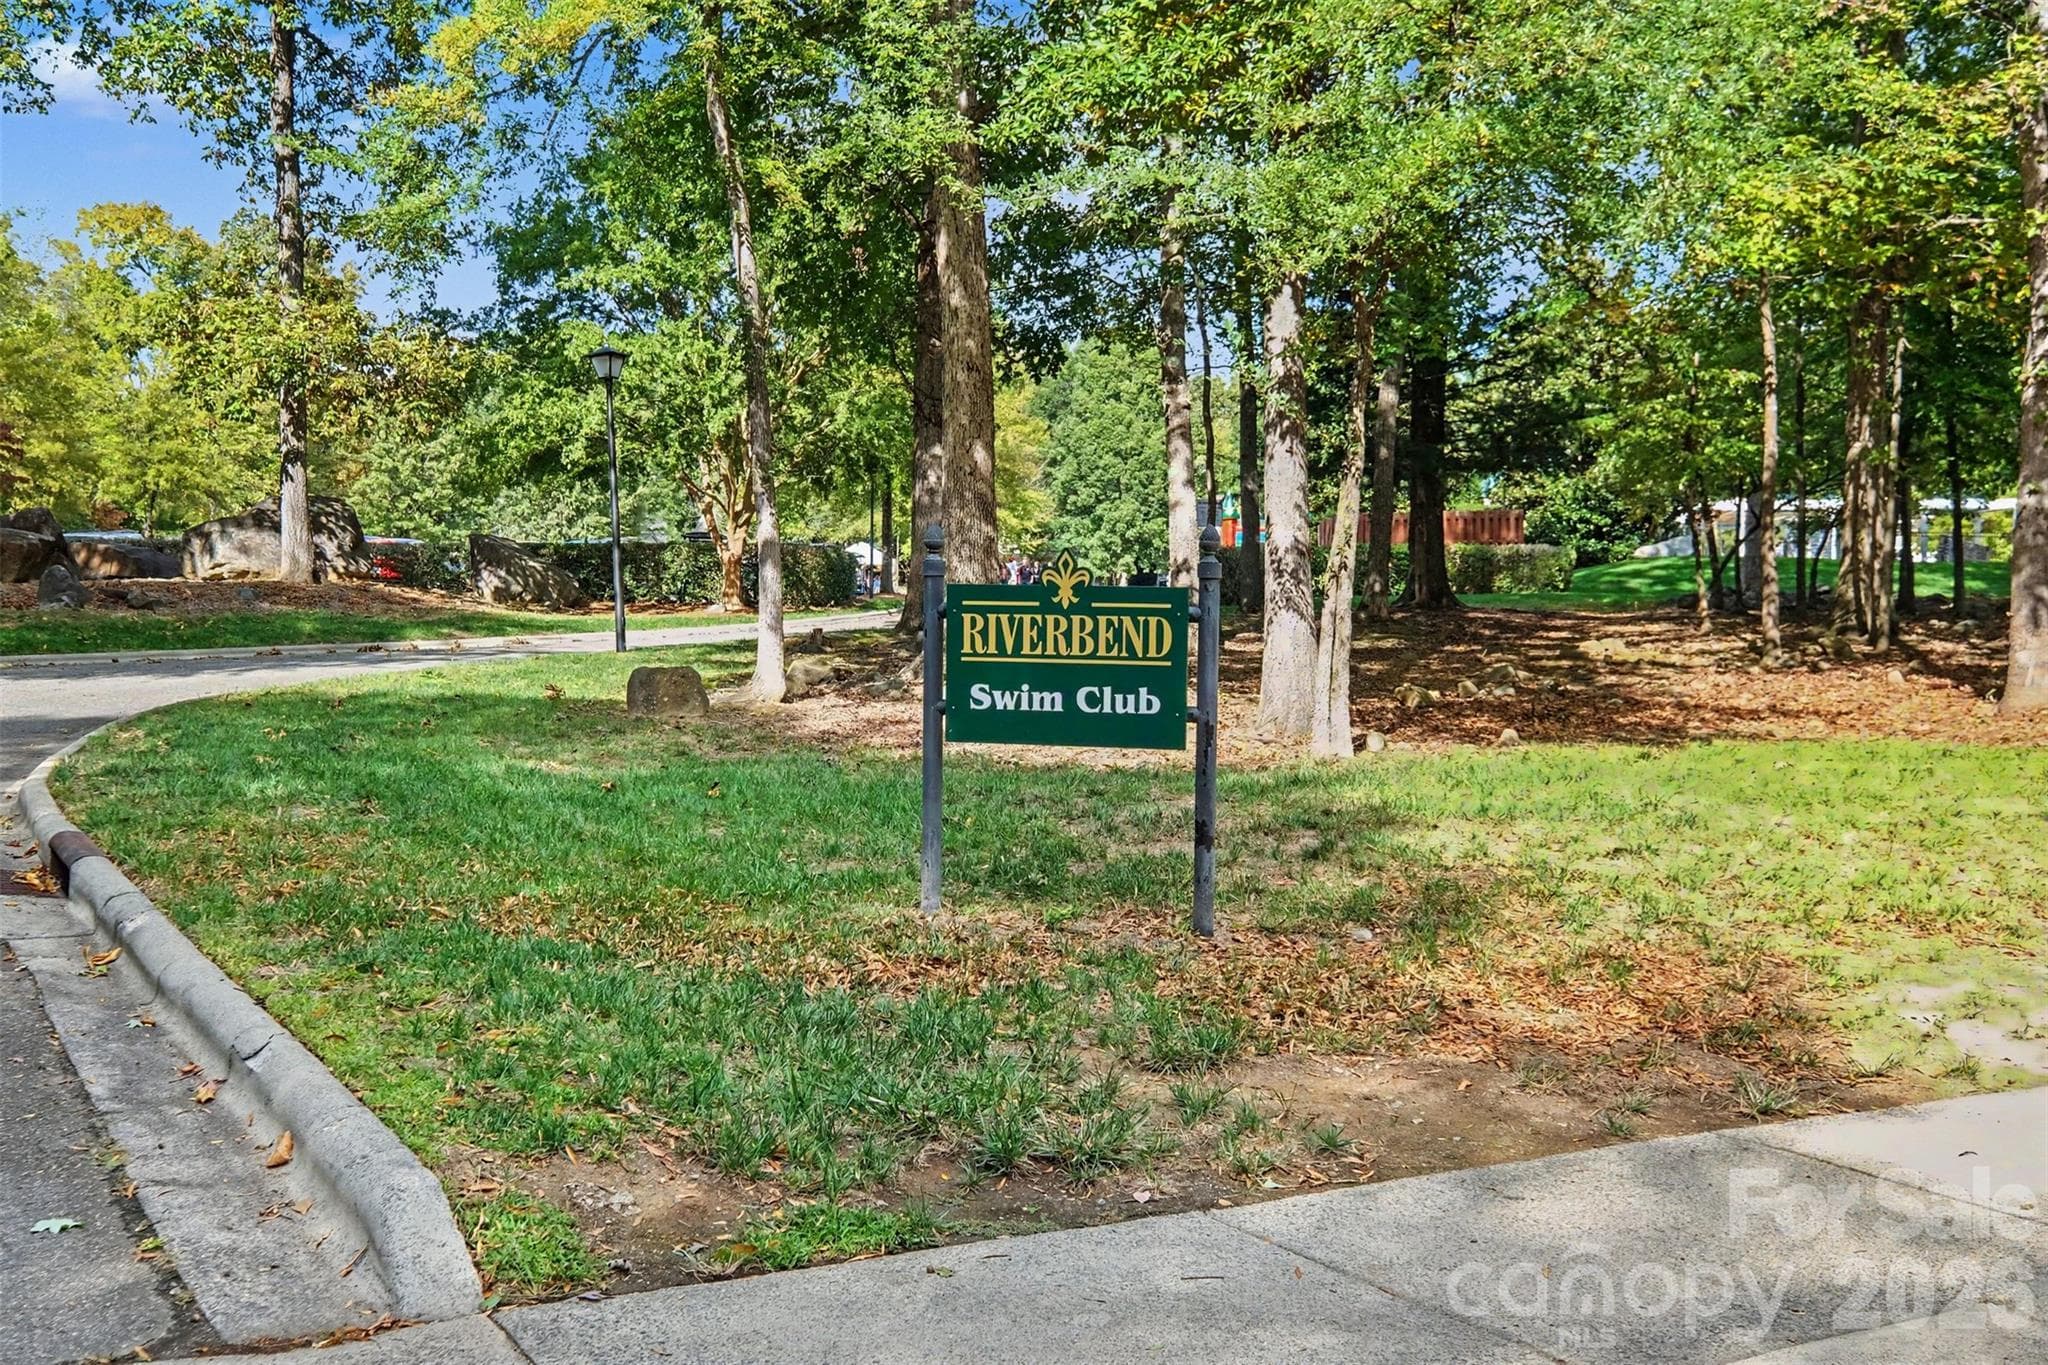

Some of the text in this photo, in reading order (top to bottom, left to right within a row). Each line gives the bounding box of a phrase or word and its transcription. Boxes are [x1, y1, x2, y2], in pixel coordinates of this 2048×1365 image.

[961, 613, 1172, 657] RIVERBEND
[970, 684, 1161, 714] Swim Club
